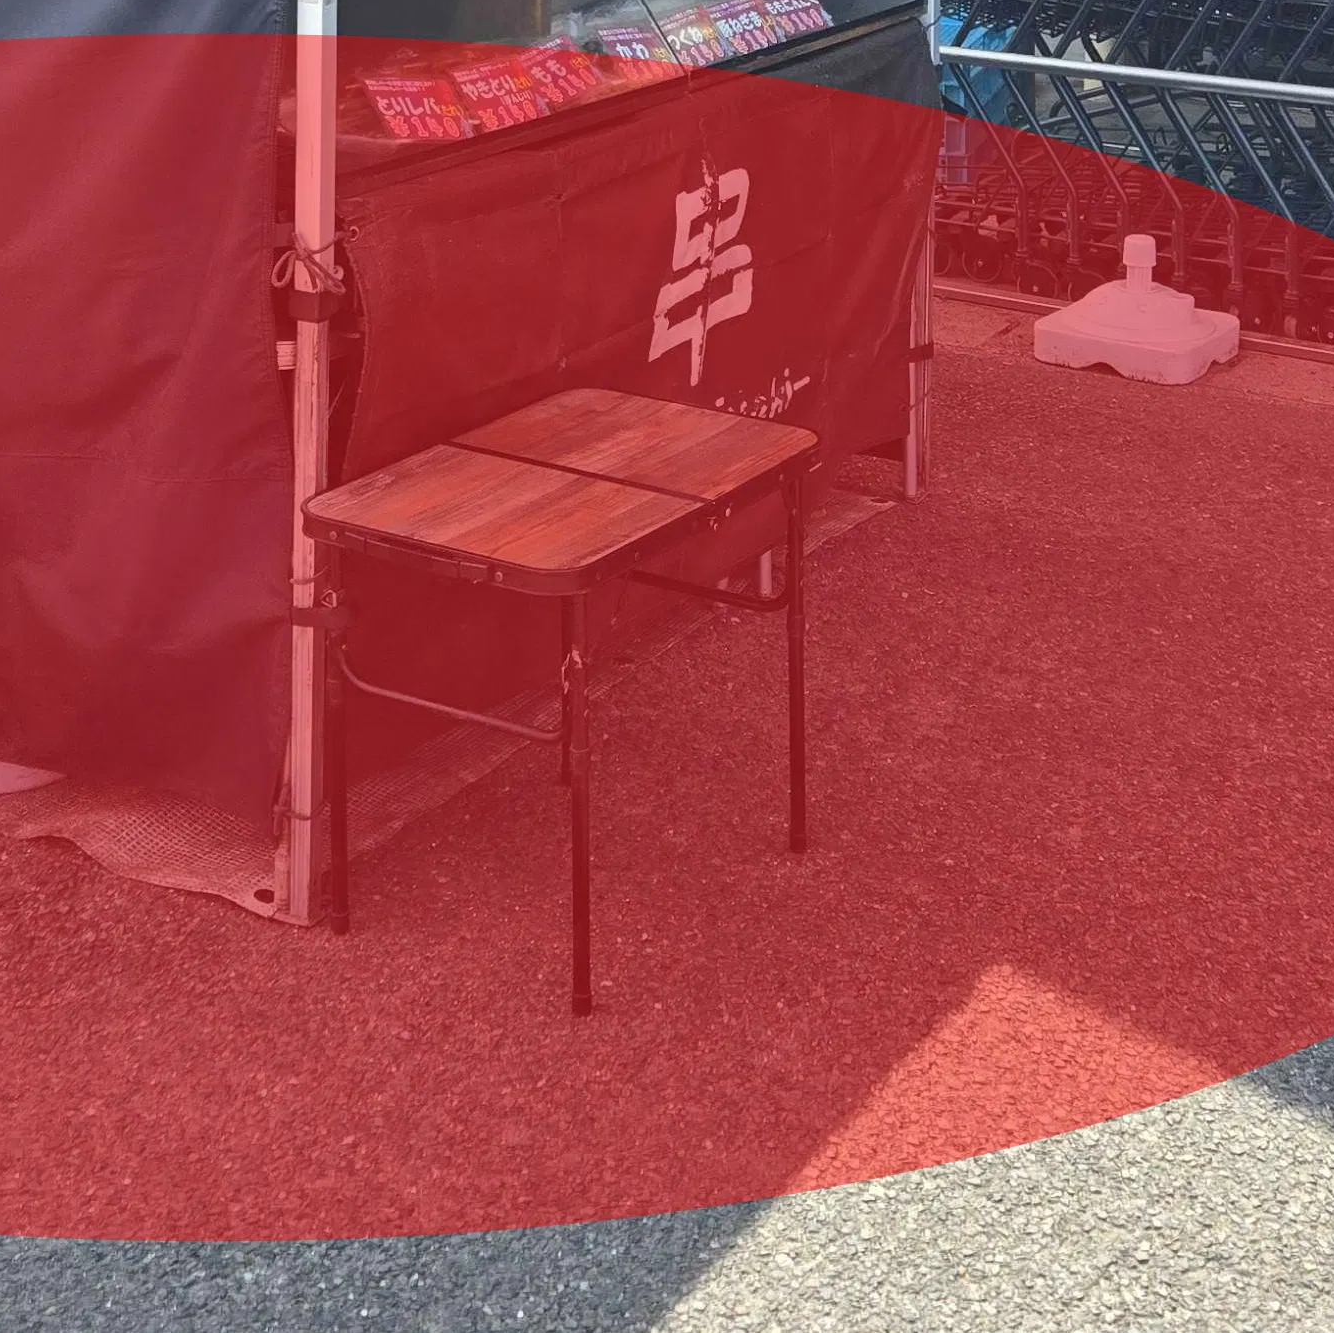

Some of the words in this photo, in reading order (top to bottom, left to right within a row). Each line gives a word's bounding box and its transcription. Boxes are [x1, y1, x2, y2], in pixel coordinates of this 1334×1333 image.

[667, 26, 703, 51] つくね
[531, 59, 567, 84] もも
[460, 74, 517, 101] やきとり
[649, 160, 753, 386] 串
